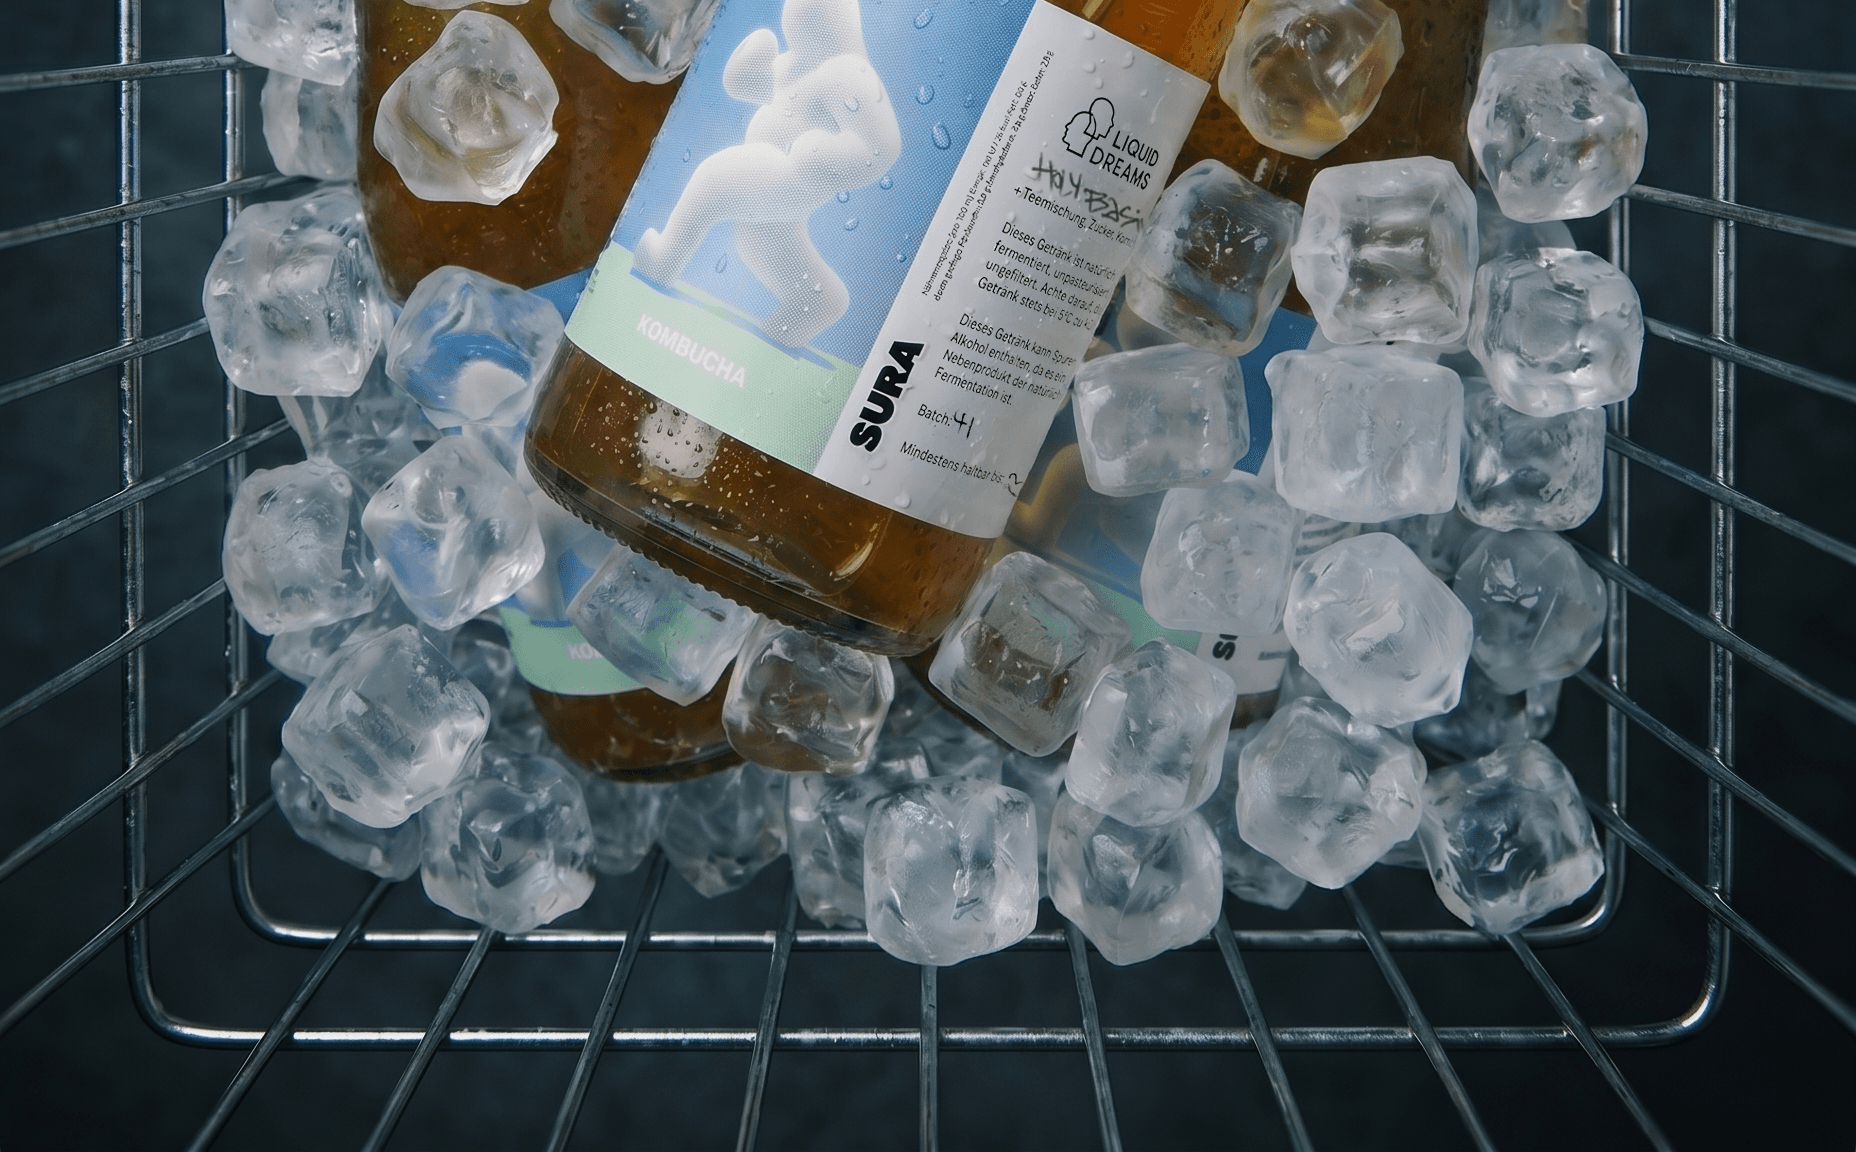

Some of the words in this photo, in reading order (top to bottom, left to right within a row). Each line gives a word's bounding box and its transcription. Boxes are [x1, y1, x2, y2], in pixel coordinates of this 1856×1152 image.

[1088, 145, 1152, 191] DREAMS
[1111, 129, 1160, 168] LIQUID
[993, 239, 1053, 277] fermentiert,
[1001, 221, 1036, 247] Dieses
[1036, 237, 1073, 264] Getränk
[1072, 253, 1085, 269] ist
[977, 276, 1020, 303] Getränk
[1019, 296, 1044, 313] stets
[1042, 302, 1059, 318] bei
[985, 260, 1038, 291] ungefiltert.
[1039, 281, 1068, 302] Achte
[636, 313, 747, 388] KOMBUCHA
[949, 329, 990, 356] Alkohol
[988, 347, 1031, 373] enthalten,
[1031, 363, 1045, 377] da
[958, 312, 995, 337] Dieses
[994, 327, 1032, 351] Getränk
[1030, 341, 1052, 359] kann
[933, 365, 1000, 400] Fermentation
[999, 389, 1012, 406] ist.
[942, 348, 1012, 385] Nebenprodukt
[1011, 375, 1028, 390] der
[848, 339, 925, 452] SURA
[917, 404, 951, 427] Batch:
[900, 441, 960, 472] Mindestens
[959, 461, 992, 480] haltbar
